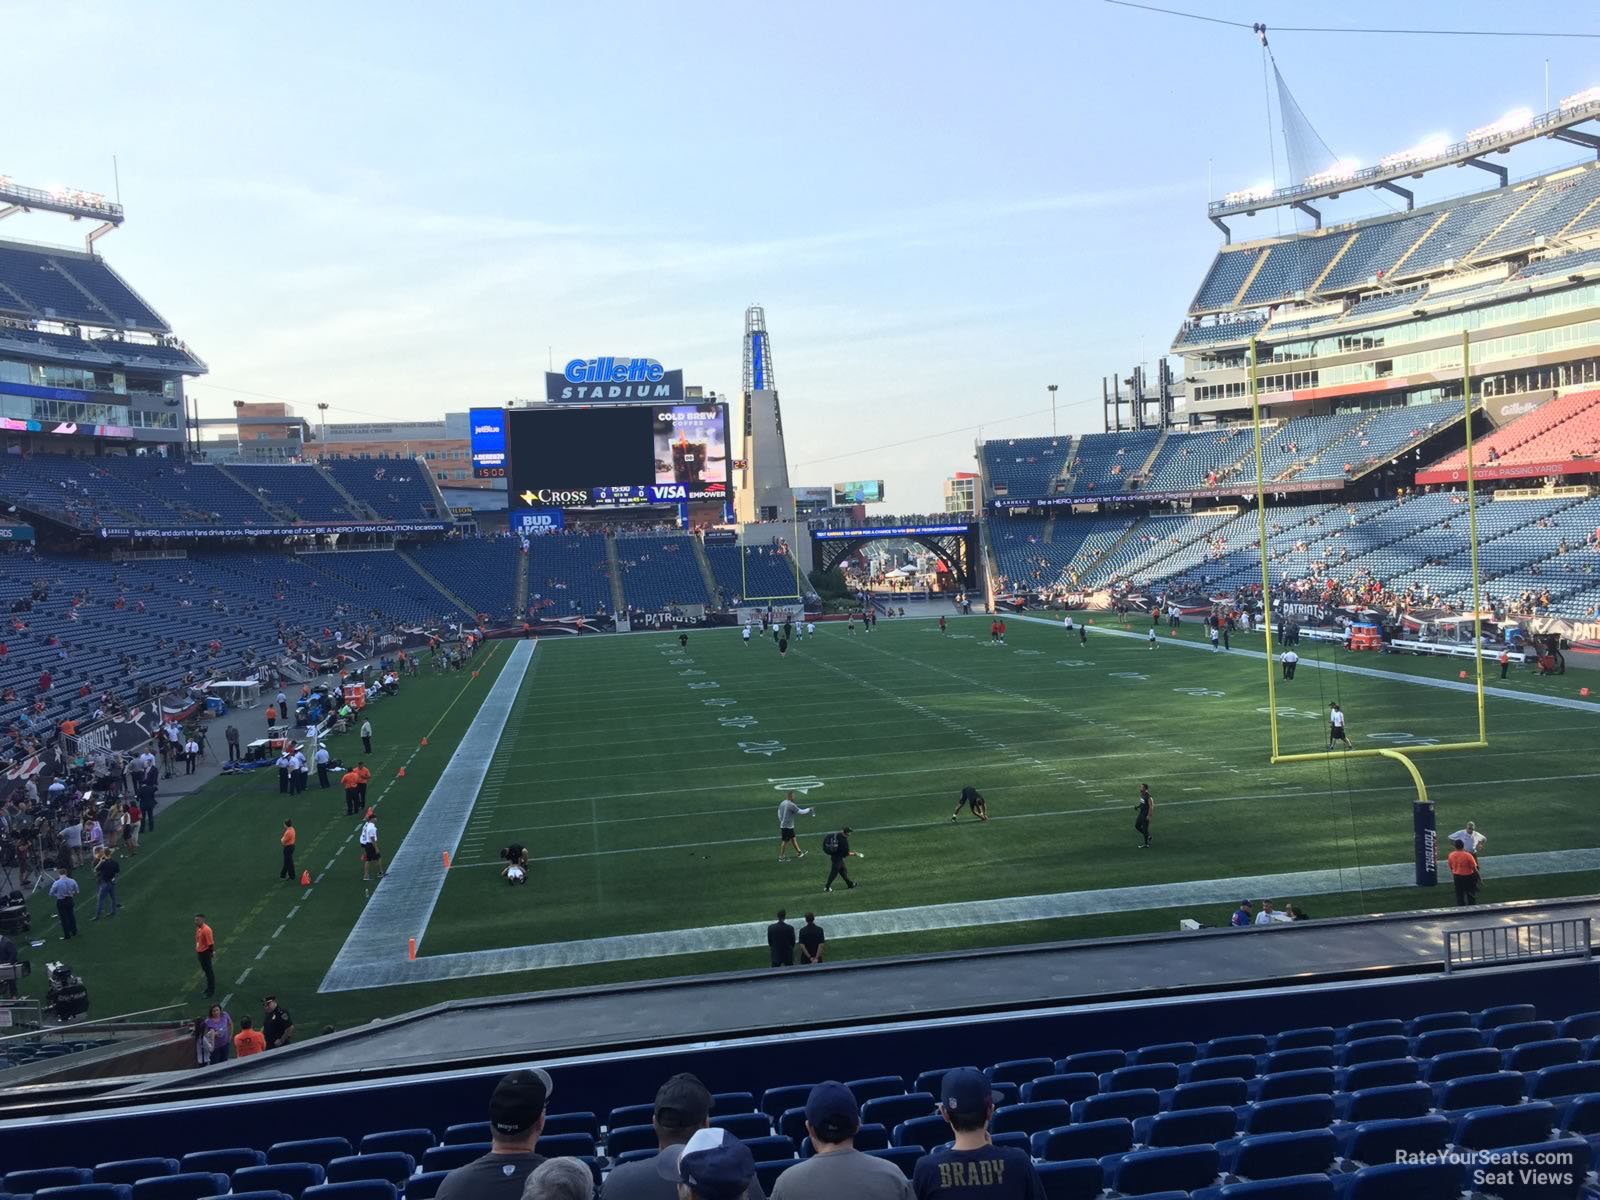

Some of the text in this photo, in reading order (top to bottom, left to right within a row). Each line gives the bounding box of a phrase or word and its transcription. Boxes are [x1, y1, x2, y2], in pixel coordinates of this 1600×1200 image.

[564, 356, 664, 383] Gillette
[561, 385, 670, 398] STADIUM
[658, 412, 716, 421] COLD BREW
[475, 425, 500, 435] jetBlue
[1474, 464, 1563, 477] TOTAL PASSING YARDS
[651, 486, 687, 499] VISA
[523, 515, 552, 525] BUD
[245, 528, 272, 536] Register
[1283, 603, 1324, 620] PATRIOTS
[938, 1160, 1004, 1188] BRADY
